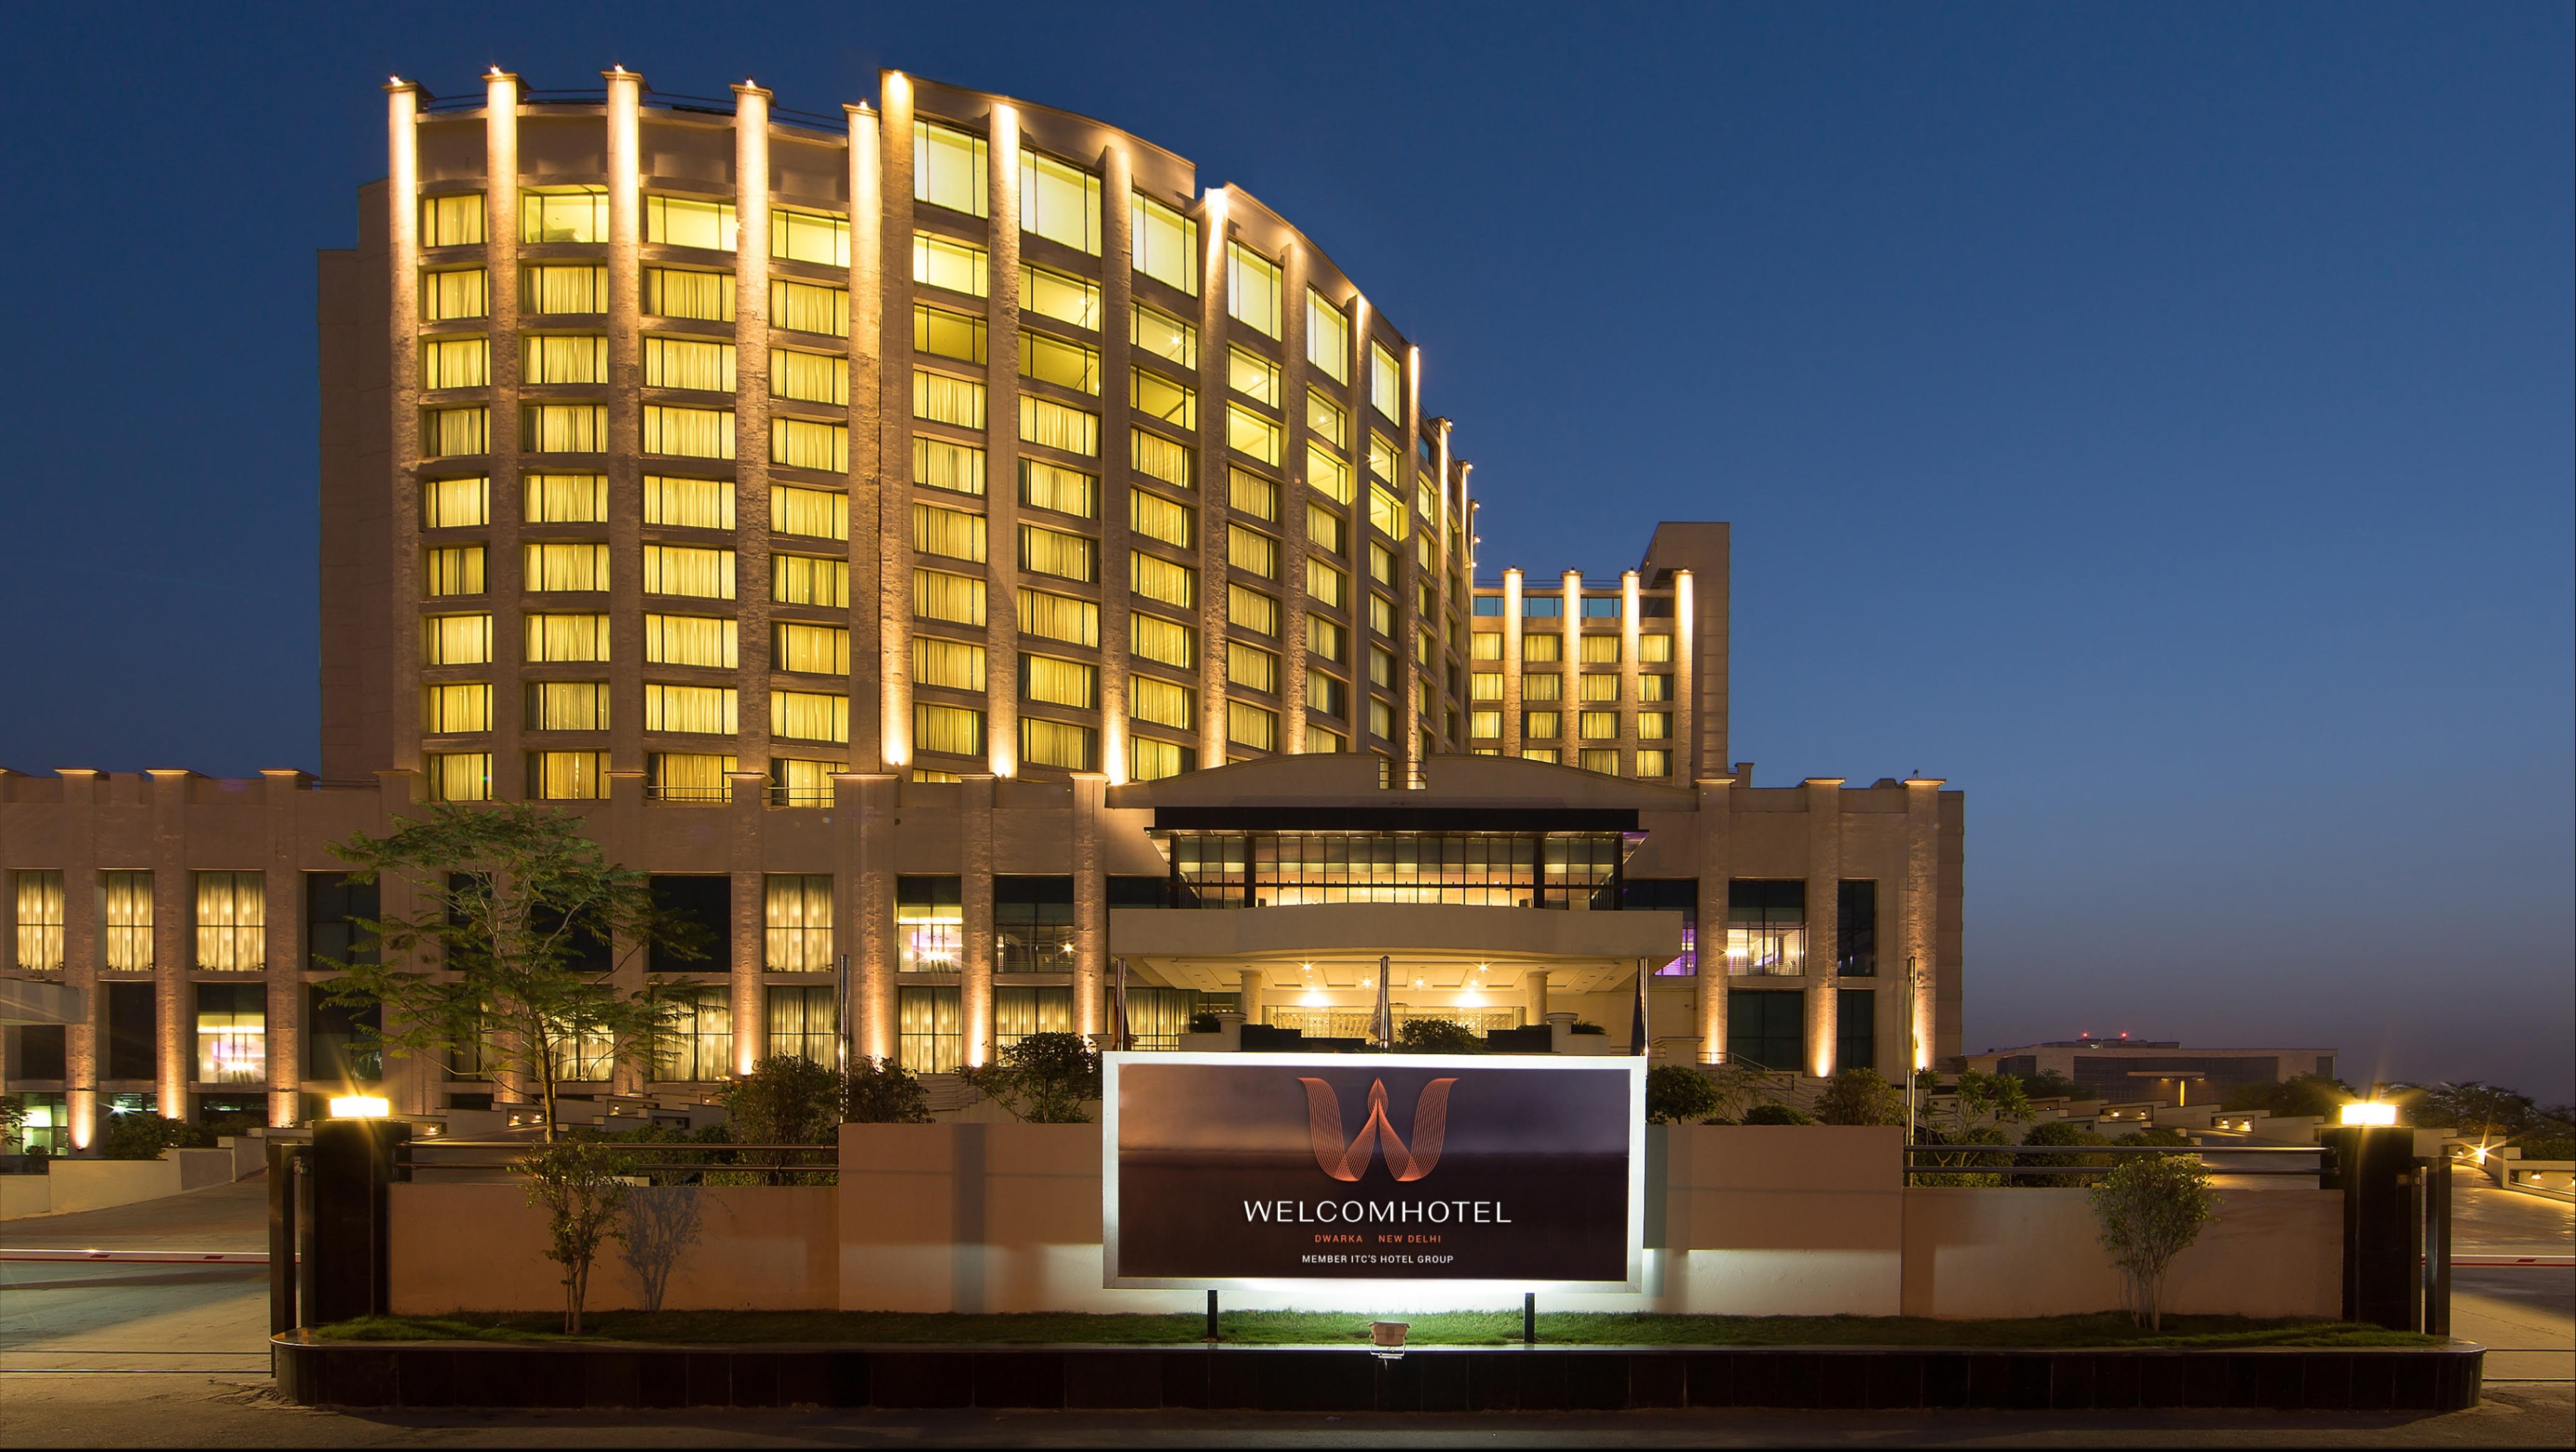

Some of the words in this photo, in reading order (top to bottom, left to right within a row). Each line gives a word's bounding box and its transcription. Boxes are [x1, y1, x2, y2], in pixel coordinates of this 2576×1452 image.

[1243, 1200, 1512, 1223] WELCOMHOTEL
[1314, 1234, 1364, 1243] DWARKA
[1378, 1234, 1403, 1243] NEW
[1408, 1234, 1441, 1244] DELHI
[1302, 1254, 1347, 1264] MEMBER
[1350, 1254, 1377, 1264] ITC'S
[1380, 1254, 1414, 1264] HOTEL
[1417, 1255, 1454, 1264] GROUP
